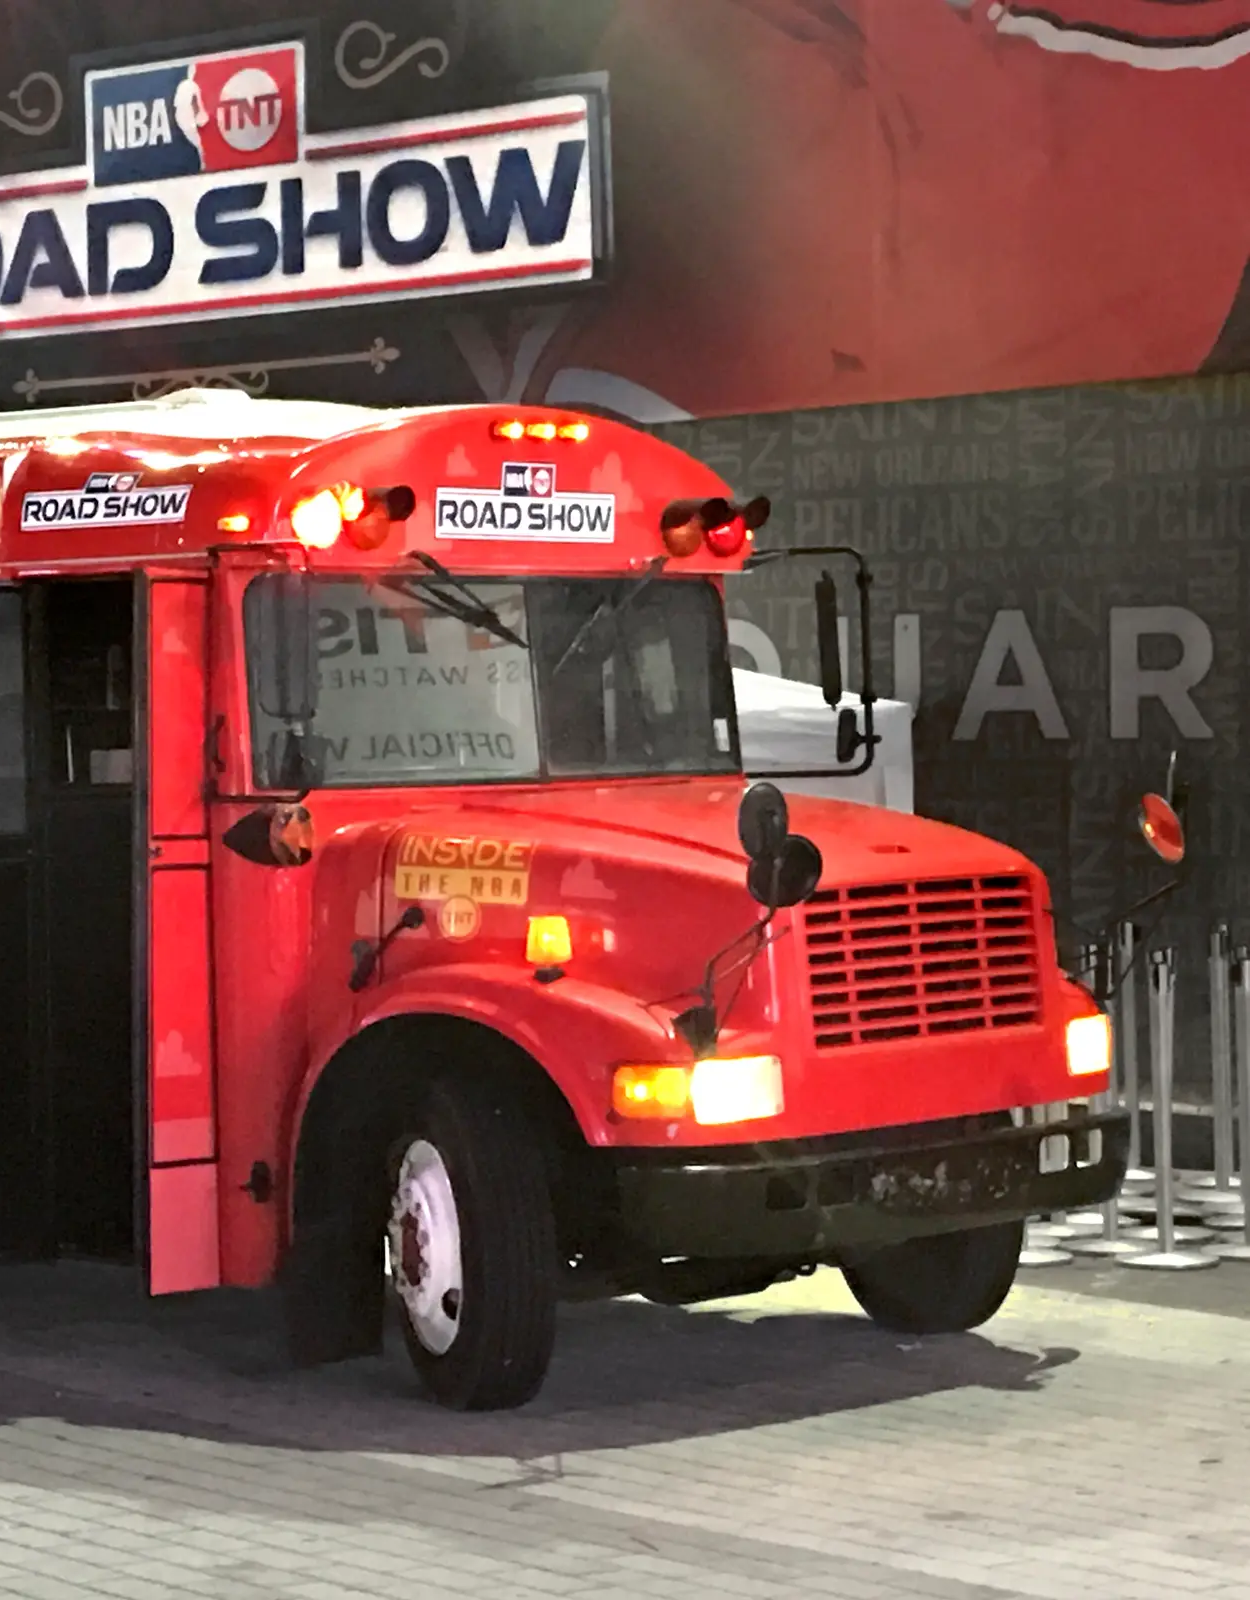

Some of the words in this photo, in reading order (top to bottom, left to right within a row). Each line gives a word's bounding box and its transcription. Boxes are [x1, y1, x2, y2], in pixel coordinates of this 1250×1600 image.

[103, 97, 173, 152] NBA
[218, 92, 283, 133] TNT
[195, 139, 586, 285] SHOW
[23, 497, 99, 523] ROAD
[103, 492, 188, 518] SHOW
[438, 499, 522, 530] ROAD
[527, 503, 612, 532] SHOW
[402, 872, 450, 894] THE
[470, 875, 523, 899] NBA
